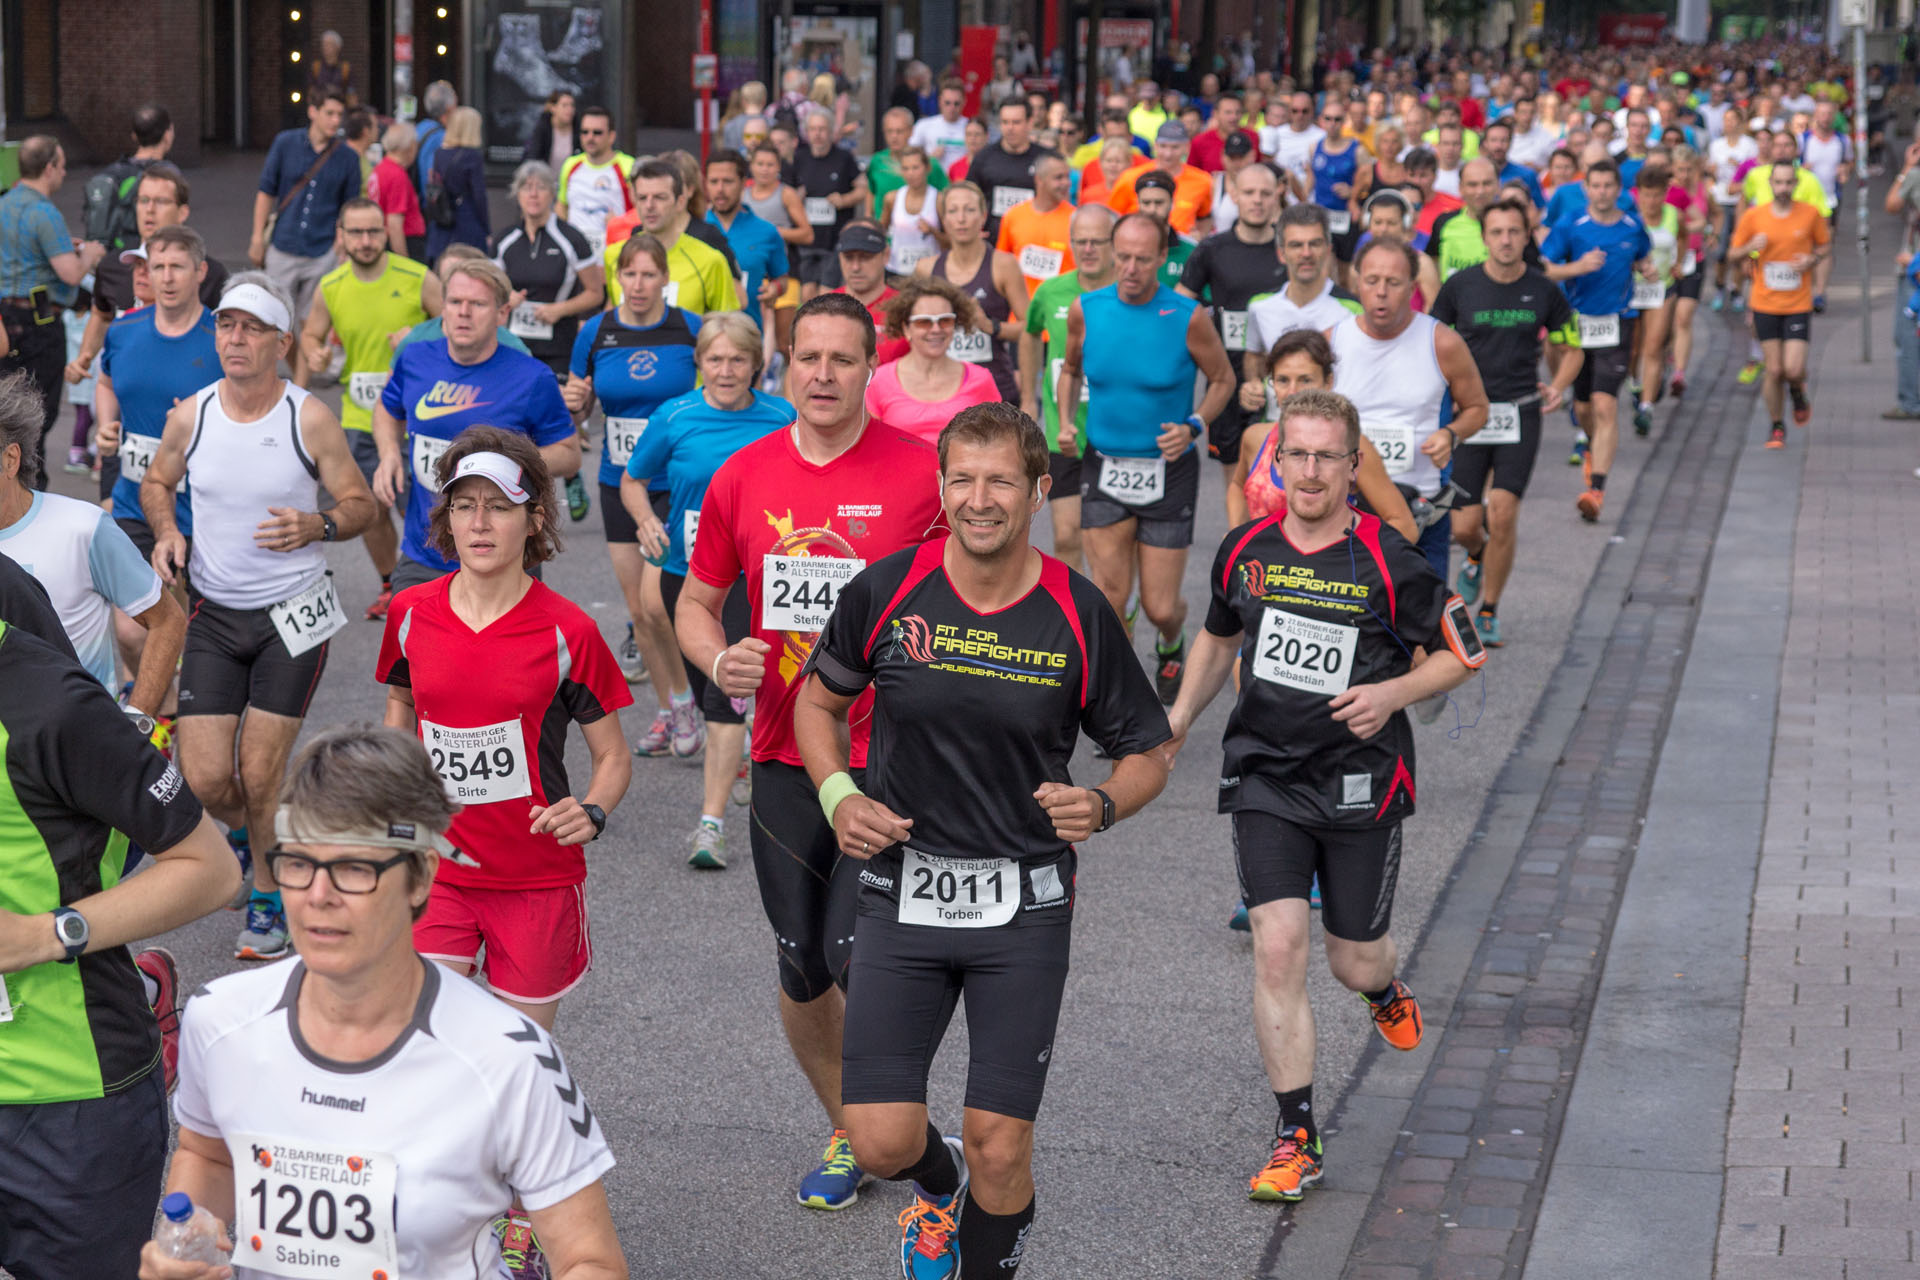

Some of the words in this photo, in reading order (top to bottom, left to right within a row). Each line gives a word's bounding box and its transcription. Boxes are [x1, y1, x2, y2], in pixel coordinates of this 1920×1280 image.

[427, 380, 482, 405] RUN
[1373, 440, 1407, 461] 32
[1107, 469, 1157, 491] 2324
[791, 568, 853, 579] ALSTERLAUF
[801, 561, 835, 569] BARMER
[835, 562, 852, 570] GEK
[1267, 565, 1285, 574] FIT
[1289, 566, 1314, 578] FOR
[1265, 574, 1369, 598] FIREFIGHTING
[285, 589, 336, 634] 1341
[793, 614, 830, 627] Steffe
[935, 624, 959, 637] FIT
[966, 628, 999, 643] FOR
[1286, 625, 1344, 644] ALSTERLAUF
[1297, 619, 1329, 632] BARMER
[1329, 627, 1345, 636] GEK
[933, 636, 1068, 668] FIREFIGHTING
[1264, 633, 1342, 674] 2020
[1273, 666, 1325, 687] Sebastian
[444, 734, 508, 749] ALSTERLAUF
[452, 730, 488, 739] BARMER
[488, 726, 507, 736] GEK
[431, 747, 515, 782] 2549
[457, 786, 488, 797] Birte
[912, 867, 1003, 904] 2011
[936, 907, 983, 920] Torben
[301, 1087, 366, 1112] hummel
[288, 1148, 344, 1167] BARMER
[273, 1160, 373, 1187] ALSTERLAUF
[251, 1178, 375, 1244] 1203
[275, 1245, 341, 1268] Sabine
